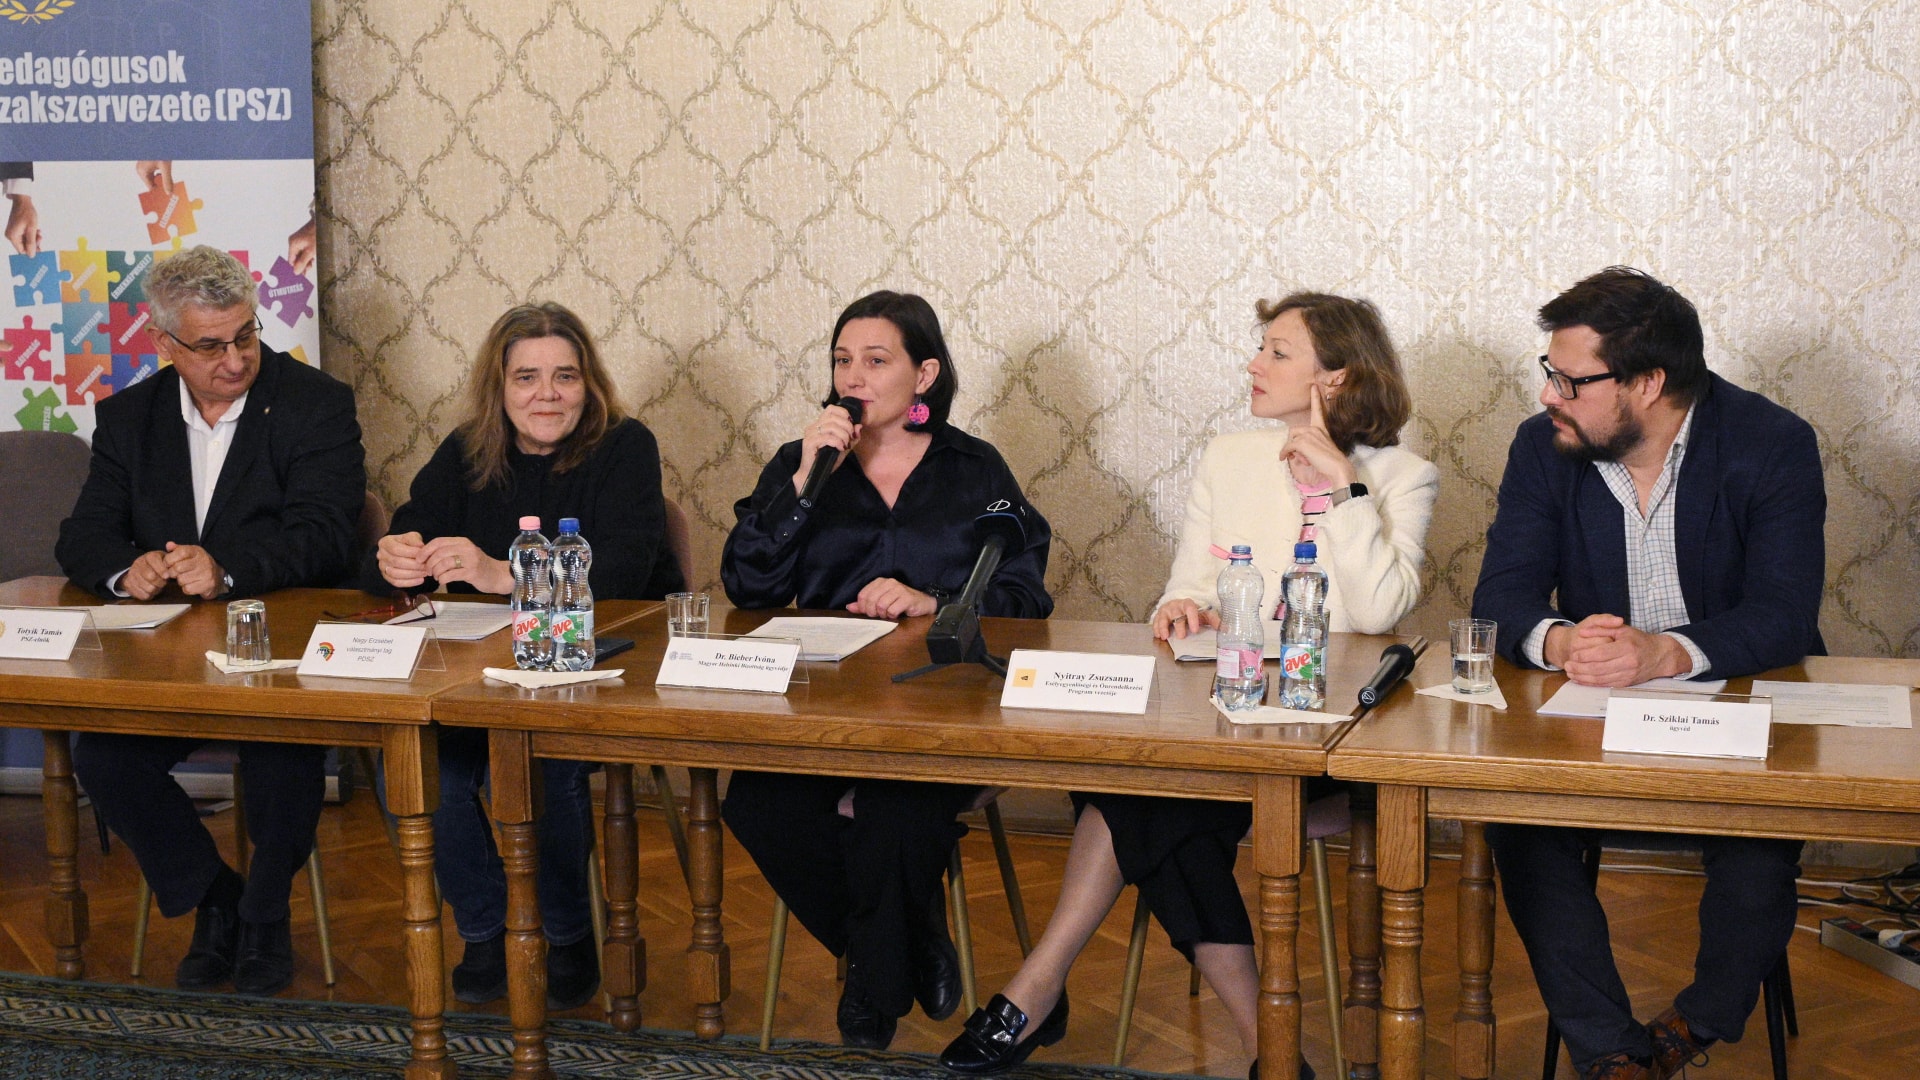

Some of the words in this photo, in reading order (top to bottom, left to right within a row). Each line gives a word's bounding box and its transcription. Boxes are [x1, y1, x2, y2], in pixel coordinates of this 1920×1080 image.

[0, 50, 187, 88] edagógusok
[0, 90, 212, 123] zakszervezete
[41, 628, 63, 636] Tamás
[352, 637, 367, 645] Nagy
[715, 652, 726, 661] Dr.
[728, 653, 752, 662] Bieber
[1285, 652, 1311, 672] ave
[1053, 671, 1086, 682] Nyitray
[1088, 673, 1134, 683] Zsuzsanna
[1642, 713, 1656, 722] Dr.
[1658, 714, 1689, 724] Sziklai
[1691, 715, 1720, 725] Tamás
